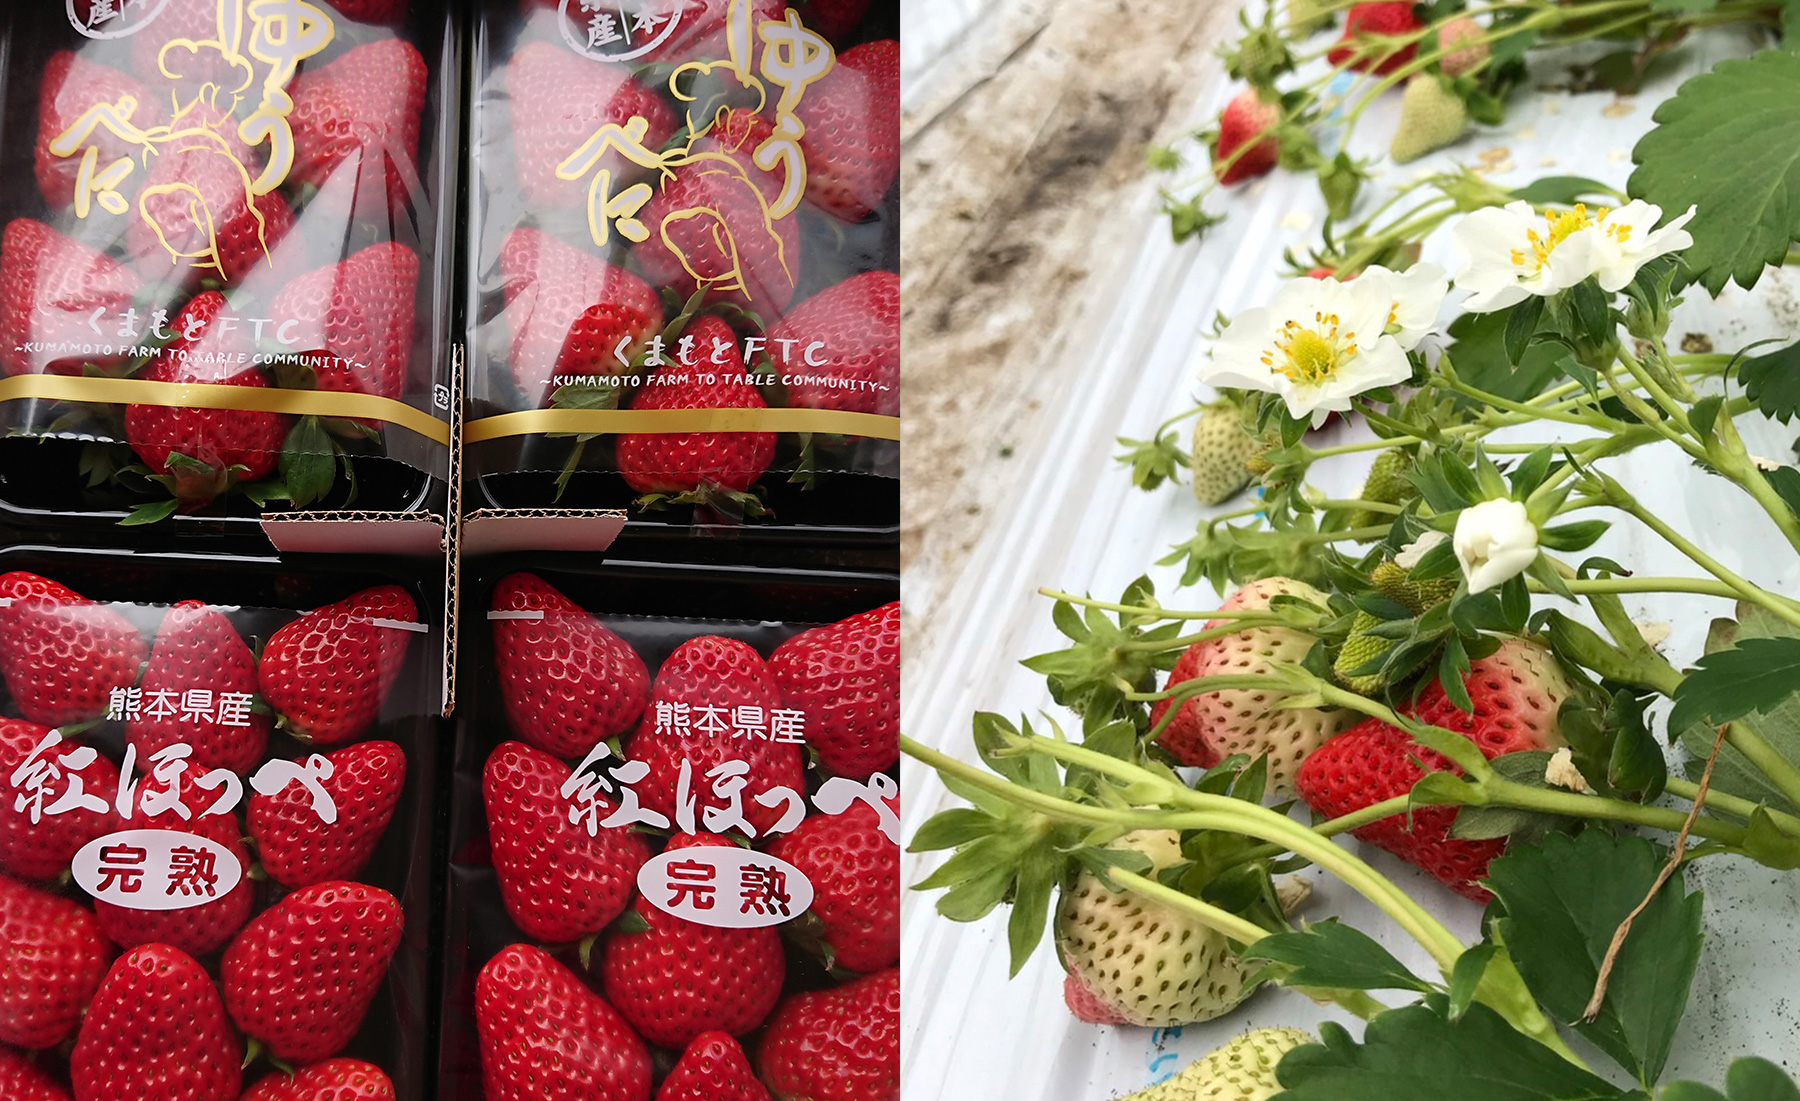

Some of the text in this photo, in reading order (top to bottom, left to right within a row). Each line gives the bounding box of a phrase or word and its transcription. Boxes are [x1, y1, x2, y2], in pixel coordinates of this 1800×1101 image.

[118, 345, 161, 358] FARM
[167, 348, 188, 361] TO
[646, 373, 689, 387] FARM
[695, 373, 716, 386] TO
[723, 373, 777, 387] TABLE
[106, 686, 254, 728] 熊本県産
[655, 700, 807, 745] 熊本県産
[10, 730, 338, 825] 紅ほっぺ
[560, 741, 899, 846] 紅ほっぺ
[96, 842, 219, 898] 完熟
[666, 858, 791, 918] 完熟
